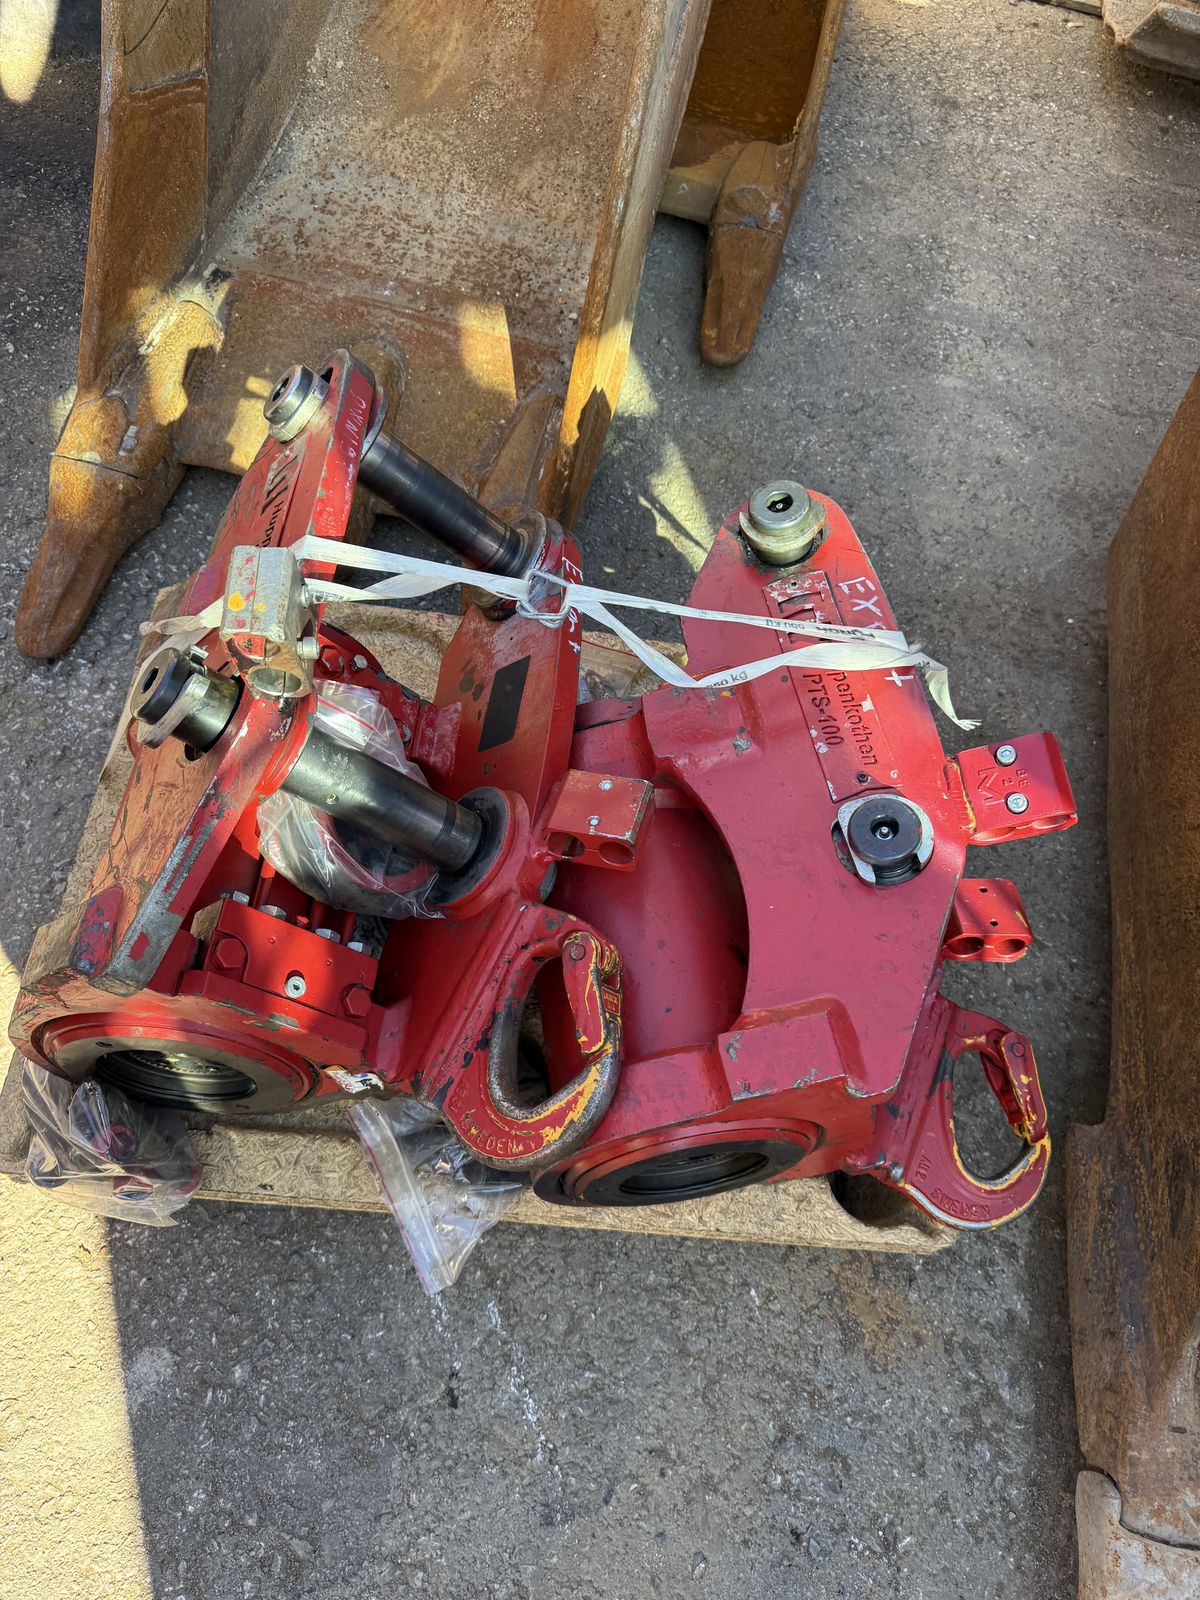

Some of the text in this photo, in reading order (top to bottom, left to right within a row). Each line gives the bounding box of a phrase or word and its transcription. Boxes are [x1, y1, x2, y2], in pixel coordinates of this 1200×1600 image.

[730, 670, 749, 682] kg
[802, 673, 845, 747] PTS-100
[826, 671, 878, 766] penkothen
